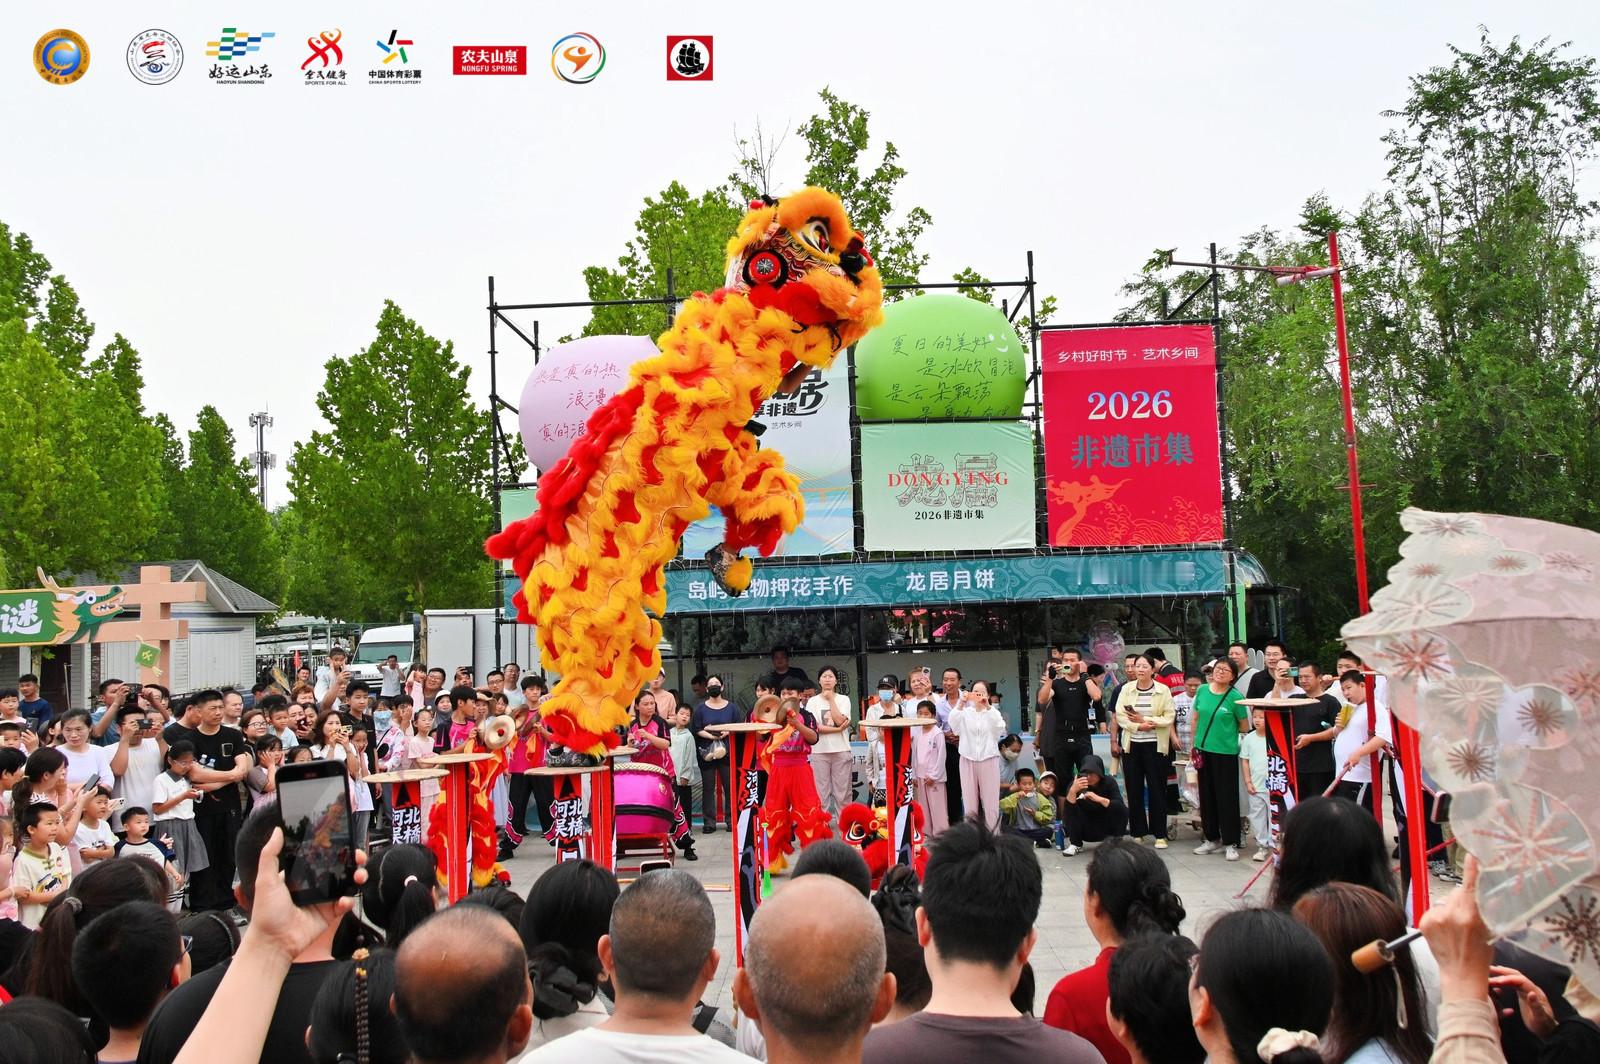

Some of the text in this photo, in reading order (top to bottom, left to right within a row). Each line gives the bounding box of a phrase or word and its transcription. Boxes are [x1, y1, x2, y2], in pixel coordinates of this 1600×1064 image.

[1087, 390, 1173, 420] 2026
[1070, 432, 1195, 469] 非遗市集
[887, 471, 1009, 487] DONGYING
[914, 509, 984, 520] 2026非遗市集
[688, 575, 853, 600] 岛屿物押花手作
[906, 570, 995, 592] 龙居月饼
[0, 598, 43, 635] 谜
[392, 806, 421, 826] 河北
[556, 798, 583, 818] 河北
